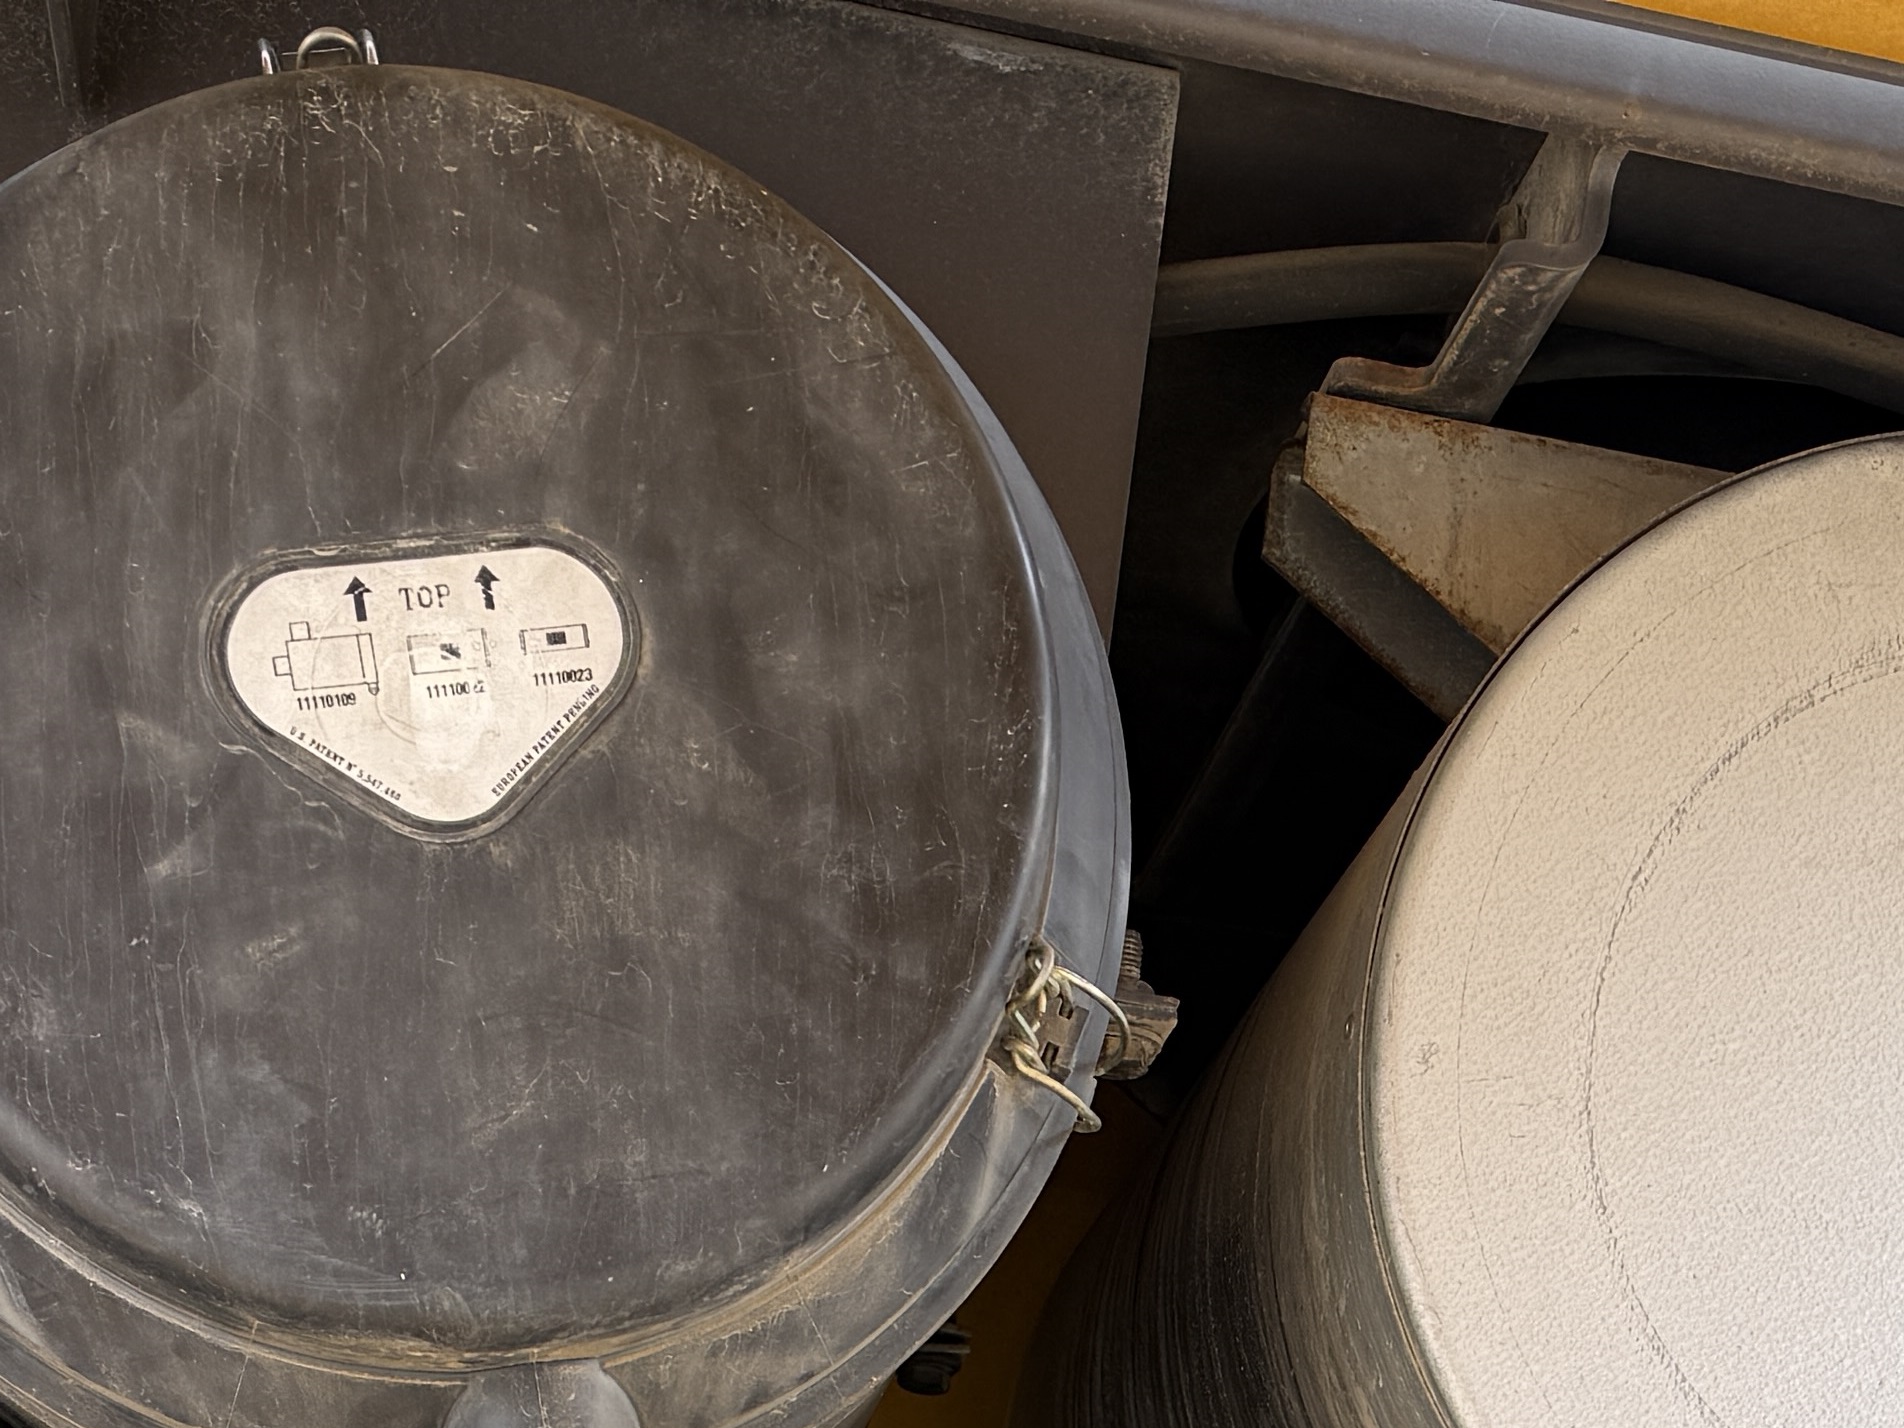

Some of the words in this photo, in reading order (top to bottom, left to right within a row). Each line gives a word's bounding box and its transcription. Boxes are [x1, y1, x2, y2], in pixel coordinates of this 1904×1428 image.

[398, 584, 451, 611] TOP
[533, 668, 593, 686] 11110023
[297, 692, 357, 711] 11110109
[491, 752, 534, 797] EUROPEAN
[532, 720, 565, 755] PATENT
